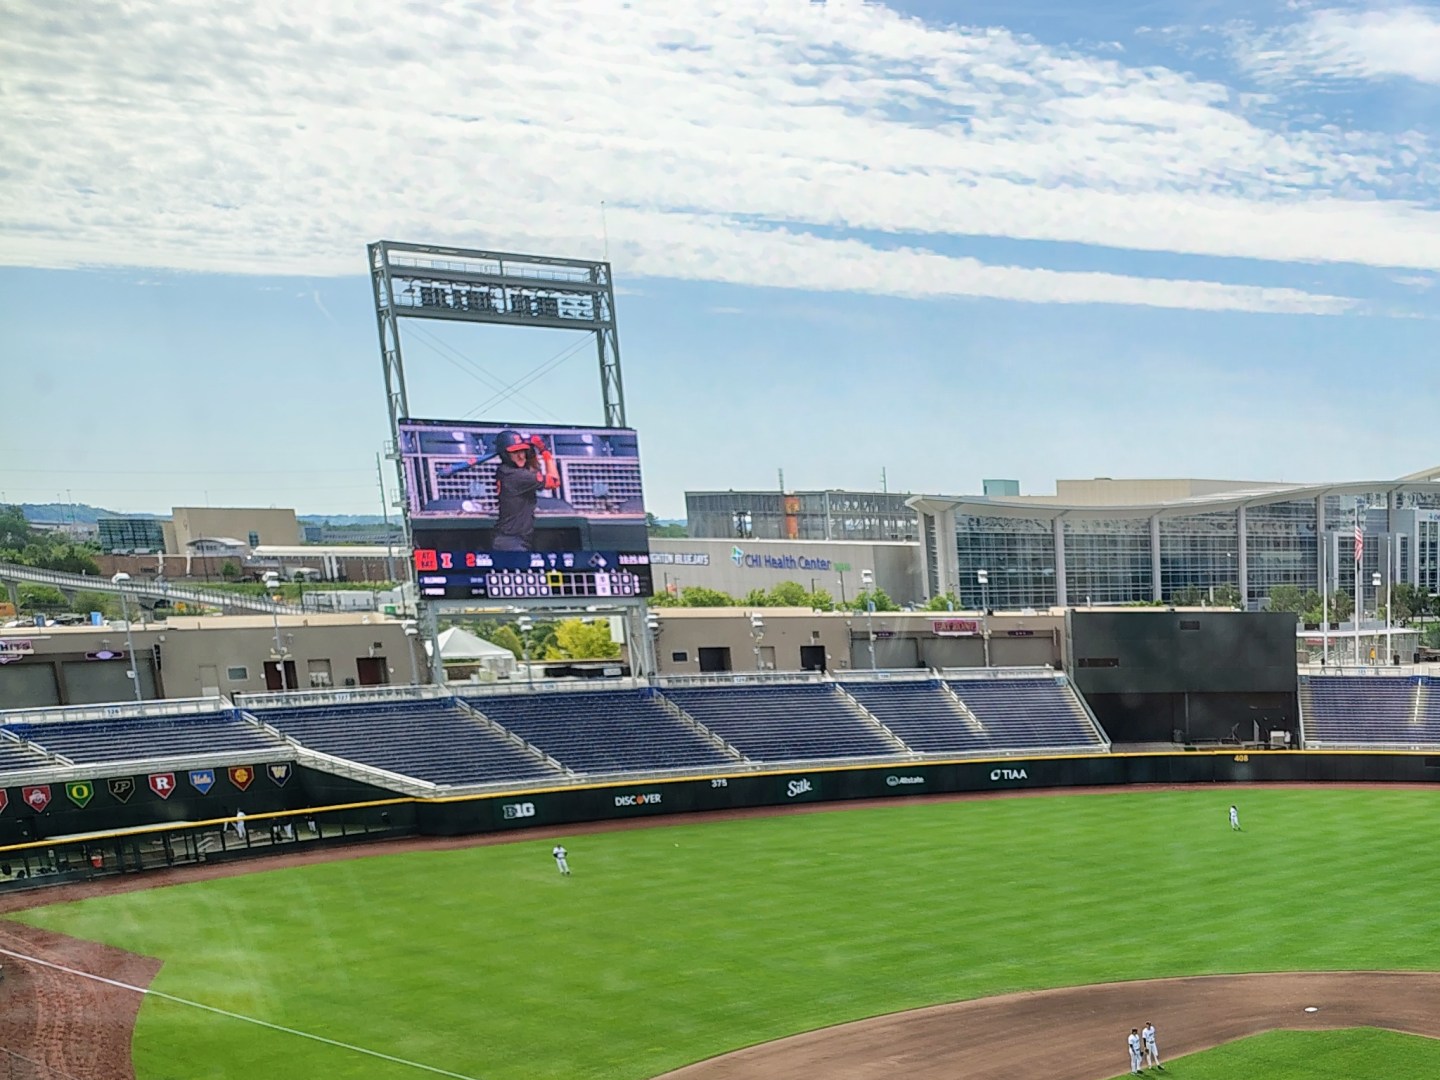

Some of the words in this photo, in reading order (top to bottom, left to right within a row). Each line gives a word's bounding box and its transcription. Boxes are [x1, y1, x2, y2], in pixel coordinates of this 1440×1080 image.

[745, 554, 761, 568] CHI
[764, 554, 797, 569] Health
[800, 555, 832, 571] Center
[1233, 754, 1249, 762] 408
[270, 765, 288, 778] W
[1002, 769, 1028, 780] TIAA
[156, 776, 171, 789] R
[711, 779, 728, 788] 375
[899, 776, 925, 784] Allstate
[72, 787, 85, 799] O
[113, 781, 131, 793] P
[787, 778, 813, 797] Silk
[614, 793, 662, 806] DISCOVER
